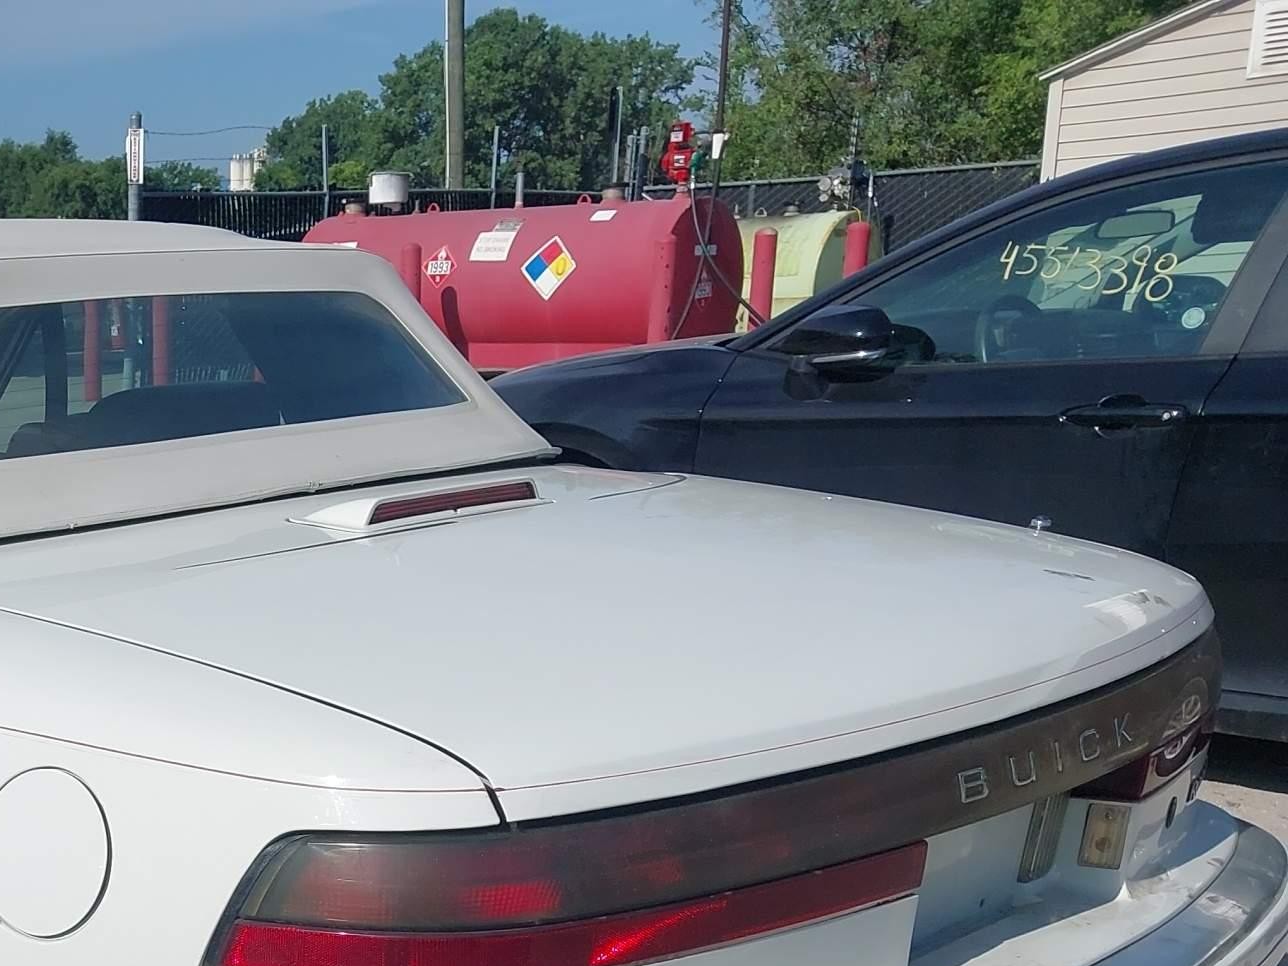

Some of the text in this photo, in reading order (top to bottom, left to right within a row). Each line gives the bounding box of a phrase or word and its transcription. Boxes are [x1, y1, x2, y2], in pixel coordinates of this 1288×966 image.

[430, 262, 450, 273] 1993
[1000, 240, 1178, 302] 45513398
[958, 712, 1132, 804] BUICK
